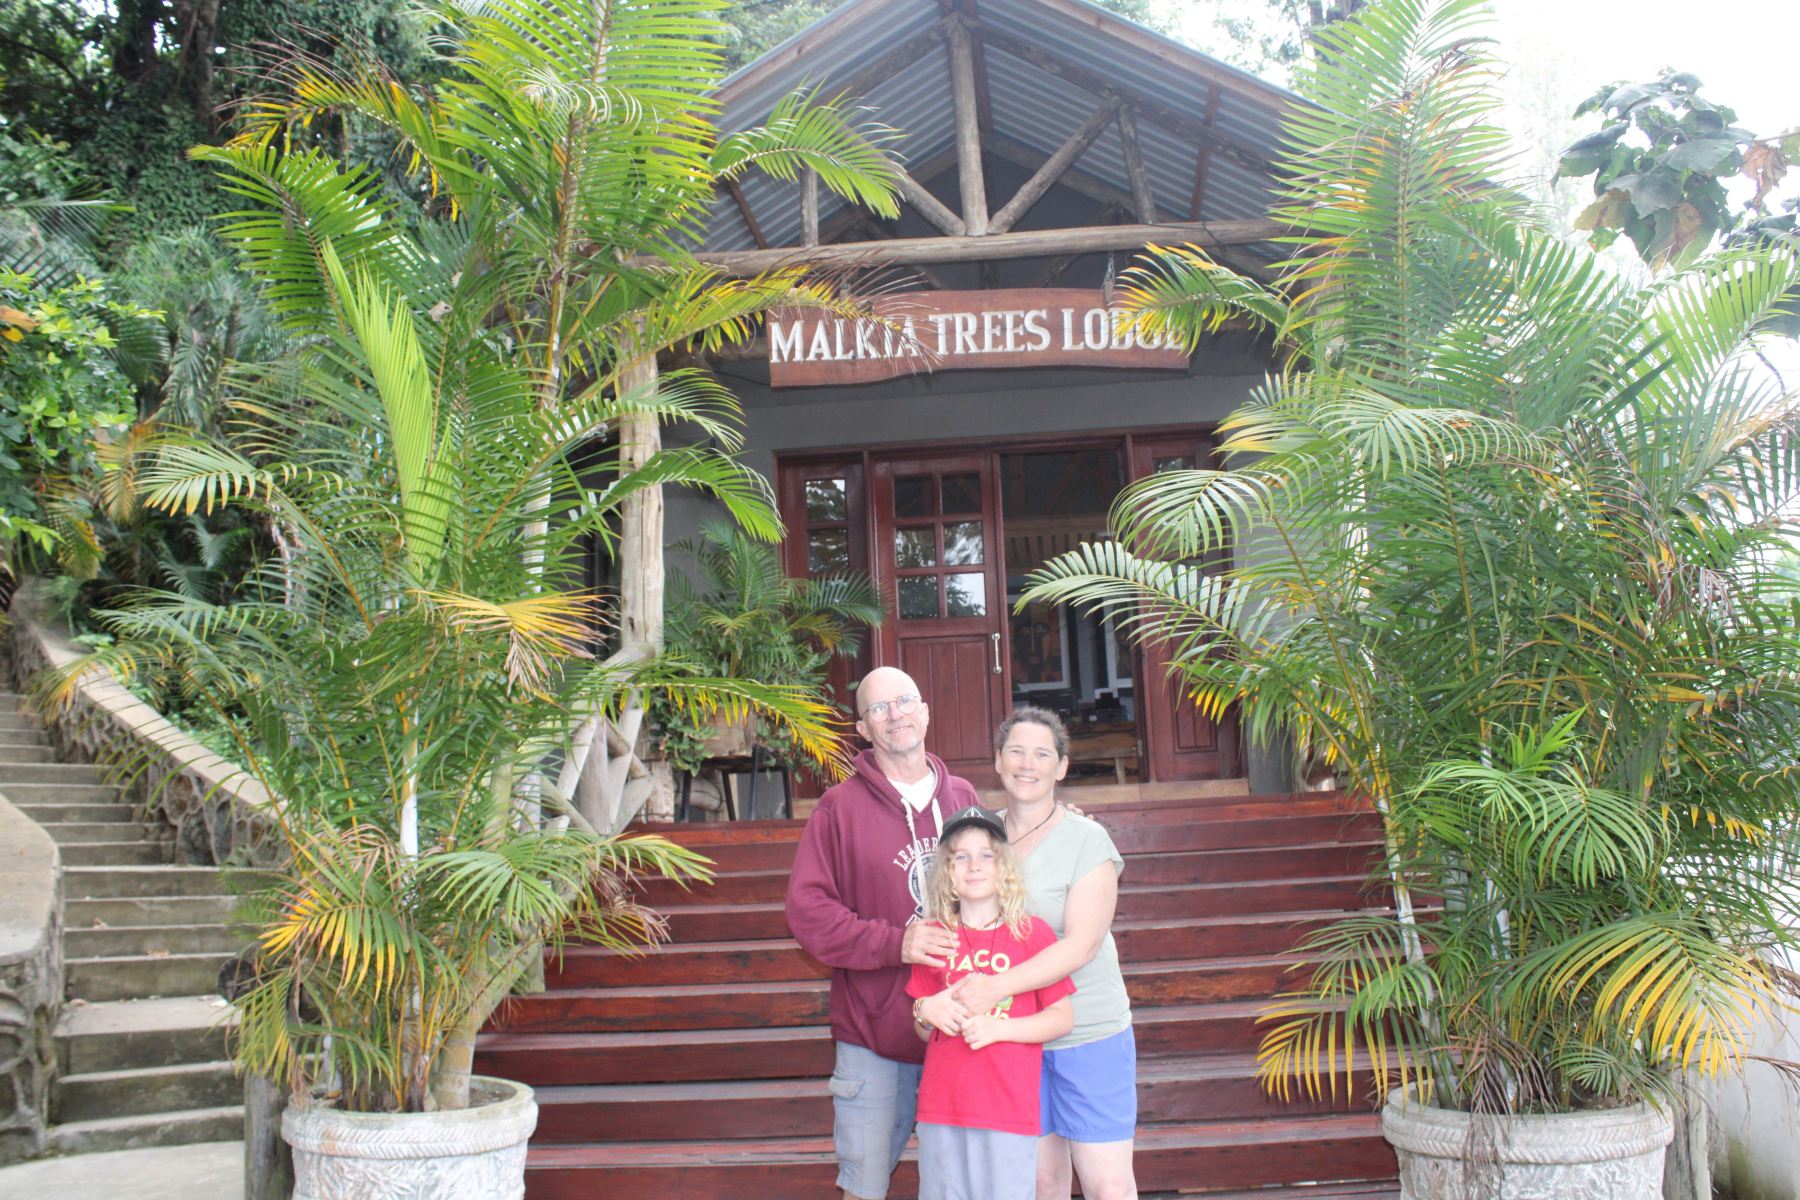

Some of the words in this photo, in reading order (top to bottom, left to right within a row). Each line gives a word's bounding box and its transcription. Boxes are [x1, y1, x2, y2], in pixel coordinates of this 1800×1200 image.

[768, 316, 919, 363] MALKIA
[928, 308, 1051, 356] TREES
[946, 949, 1010, 973] TACO
